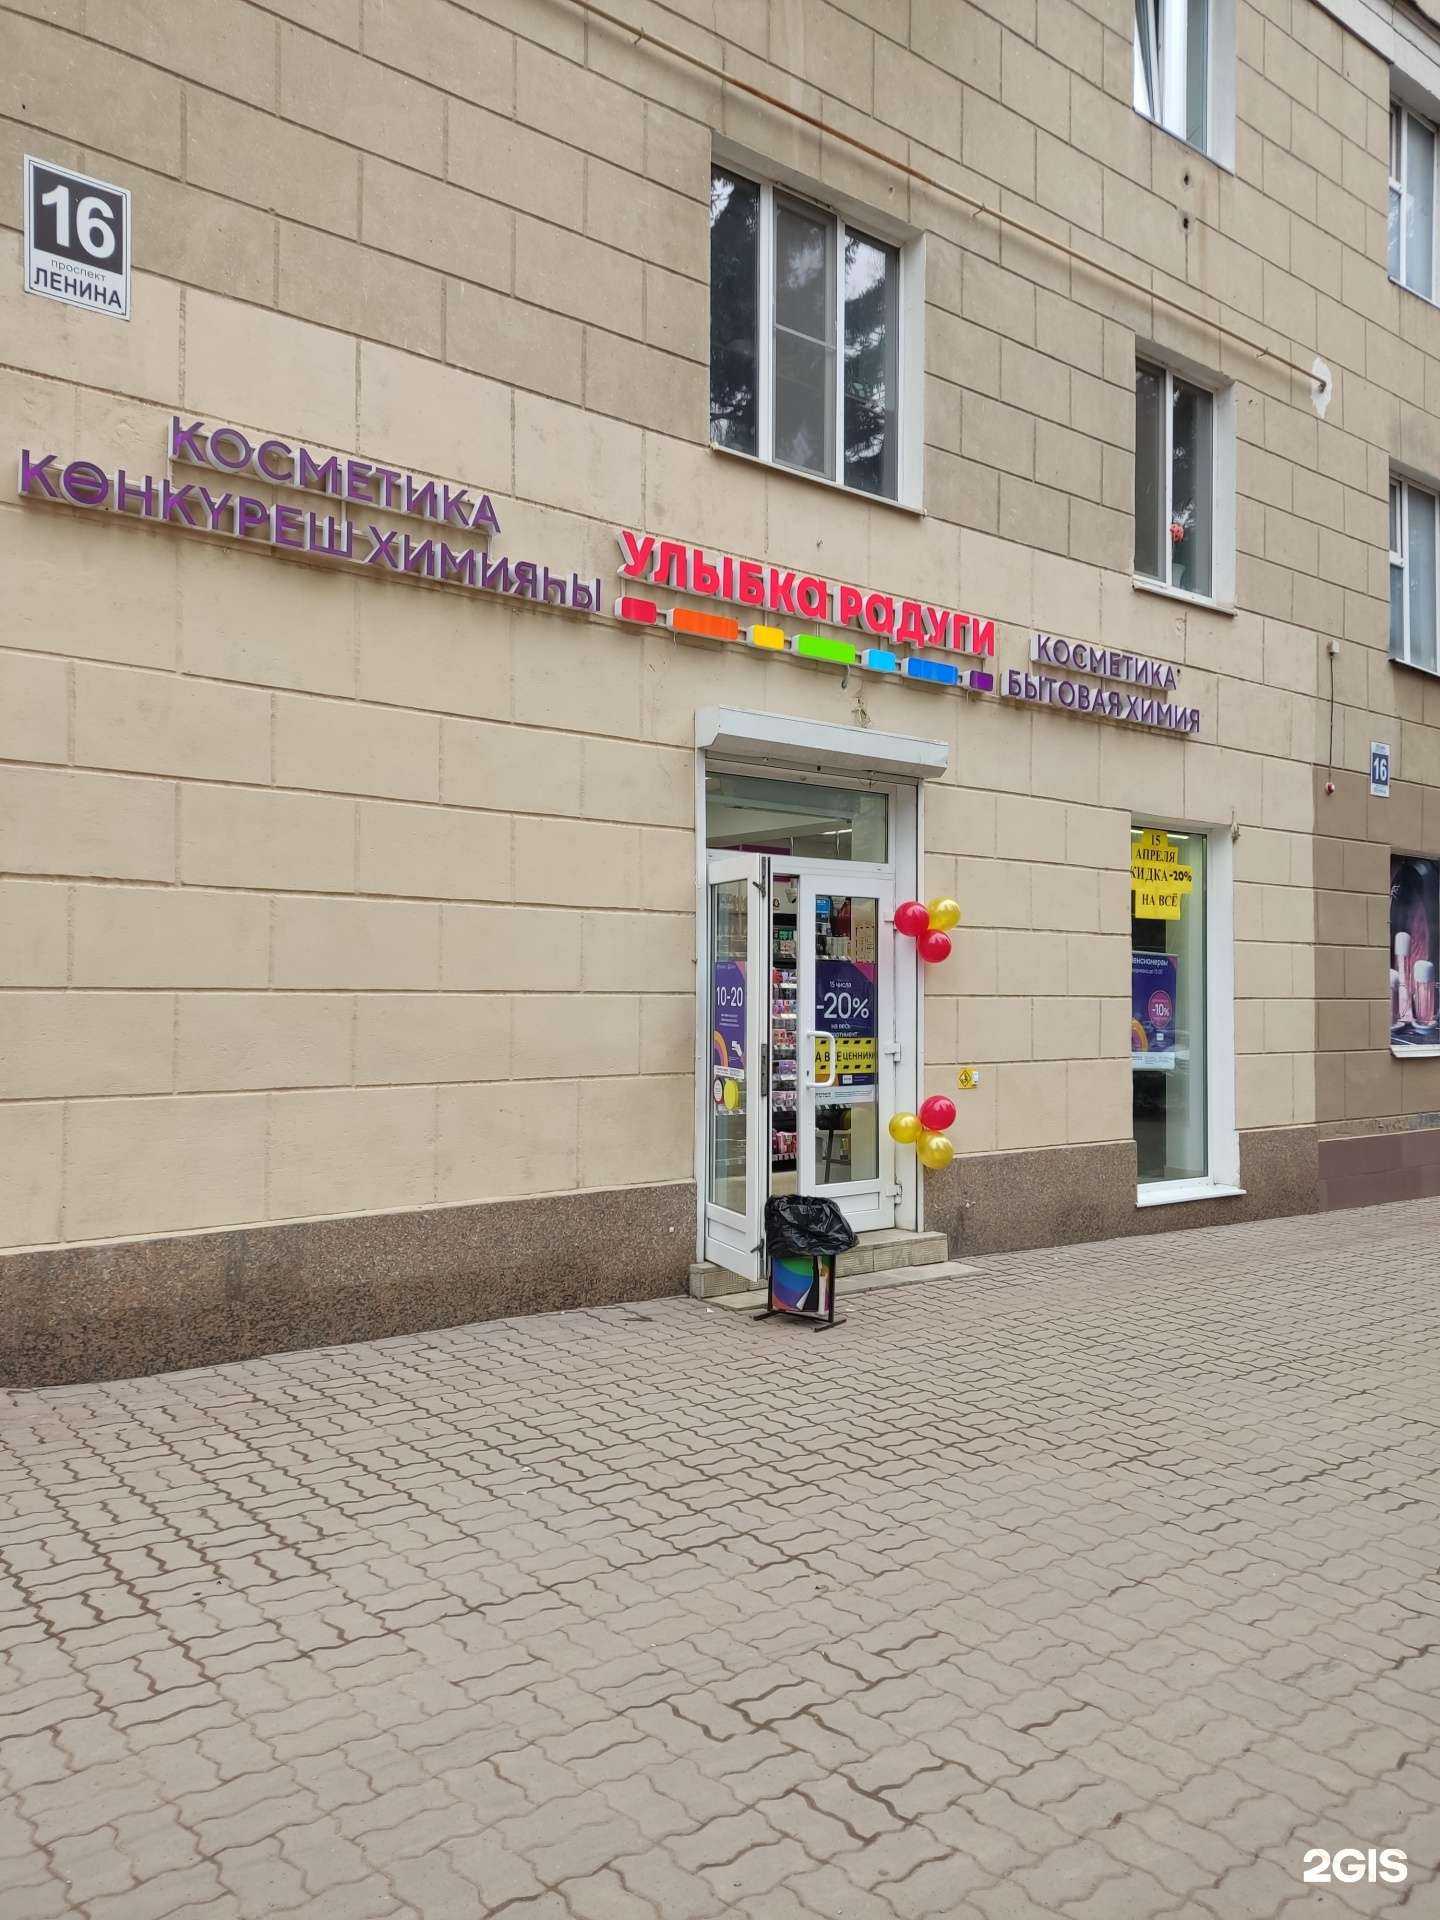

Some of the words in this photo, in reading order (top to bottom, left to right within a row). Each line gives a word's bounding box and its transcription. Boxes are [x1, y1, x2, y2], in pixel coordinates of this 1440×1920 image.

[41, 184, 116, 259] 16
[51, 258, 106, 281] проспект
[34, 267, 122, 309] ЛЕНИНА
[170, 416, 501, 533] КОСМЕТИКА
[1034, 634, 1177, 690] КОСМЕТИКА
[1006, 669, 1121, 718] БЫТОВАЯ
[1126, 695, 1200, 733] ХИМИЯ
[1373, 757, 1388, 781] 16
[1136, 847, 1176, 863] АПРЕЛЯ
[1130, 866, 1168, 882] КИДКА
[1142, 894, 1155, 906] НА
[716, 986, 744, 1007] 10-20
[816, 992, 869, 1018] -20%
[1151, 1003, 1170, 1017] -10%
[824, 1051, 842, 1062] ВЕ
